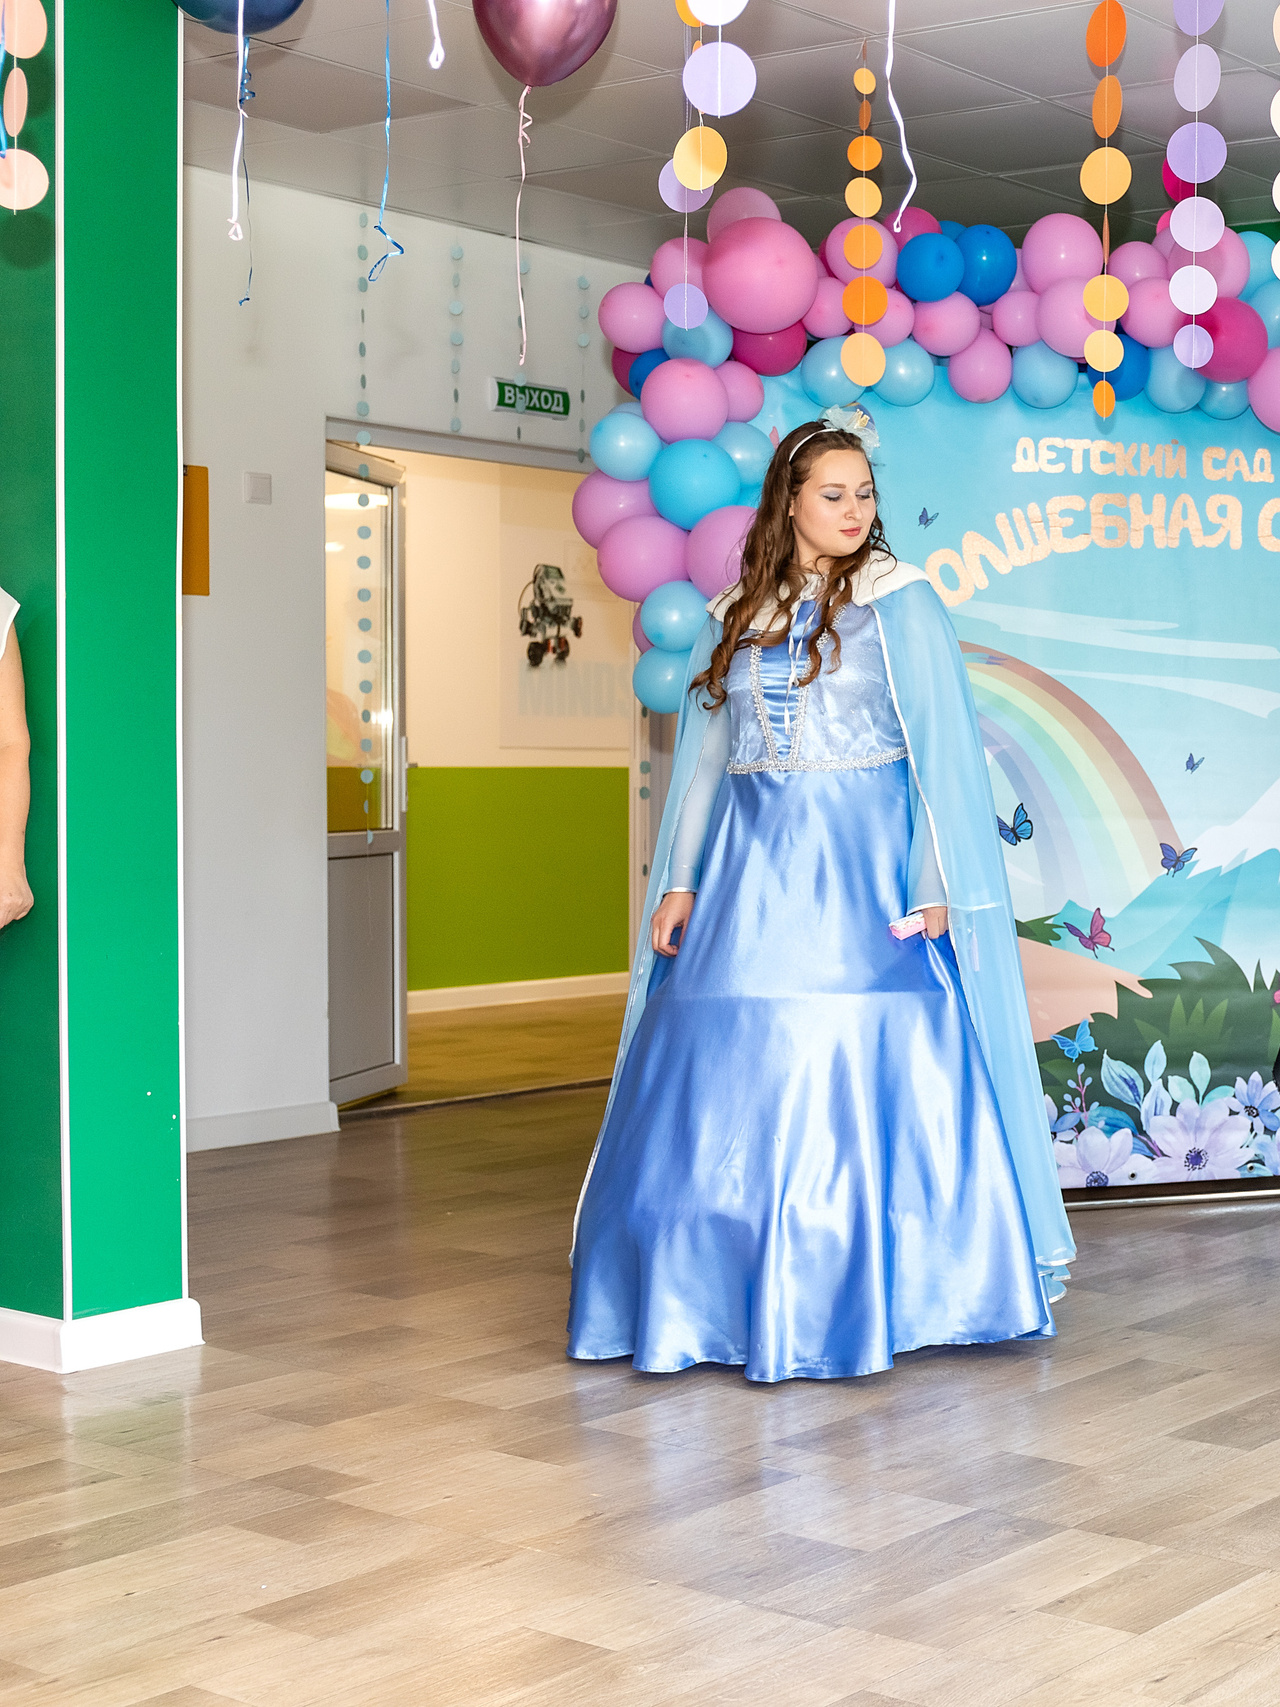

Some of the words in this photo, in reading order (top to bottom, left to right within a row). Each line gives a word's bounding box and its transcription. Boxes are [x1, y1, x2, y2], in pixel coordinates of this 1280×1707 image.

[504, 386, 564, 412] ВЫХОД
[1011, 437, 1187, 479] ДЕТСКИЙ
[1202, 446, 1275, 484] САД
[925, 493, 1243, 607] ОЛШЕБНАЯ
